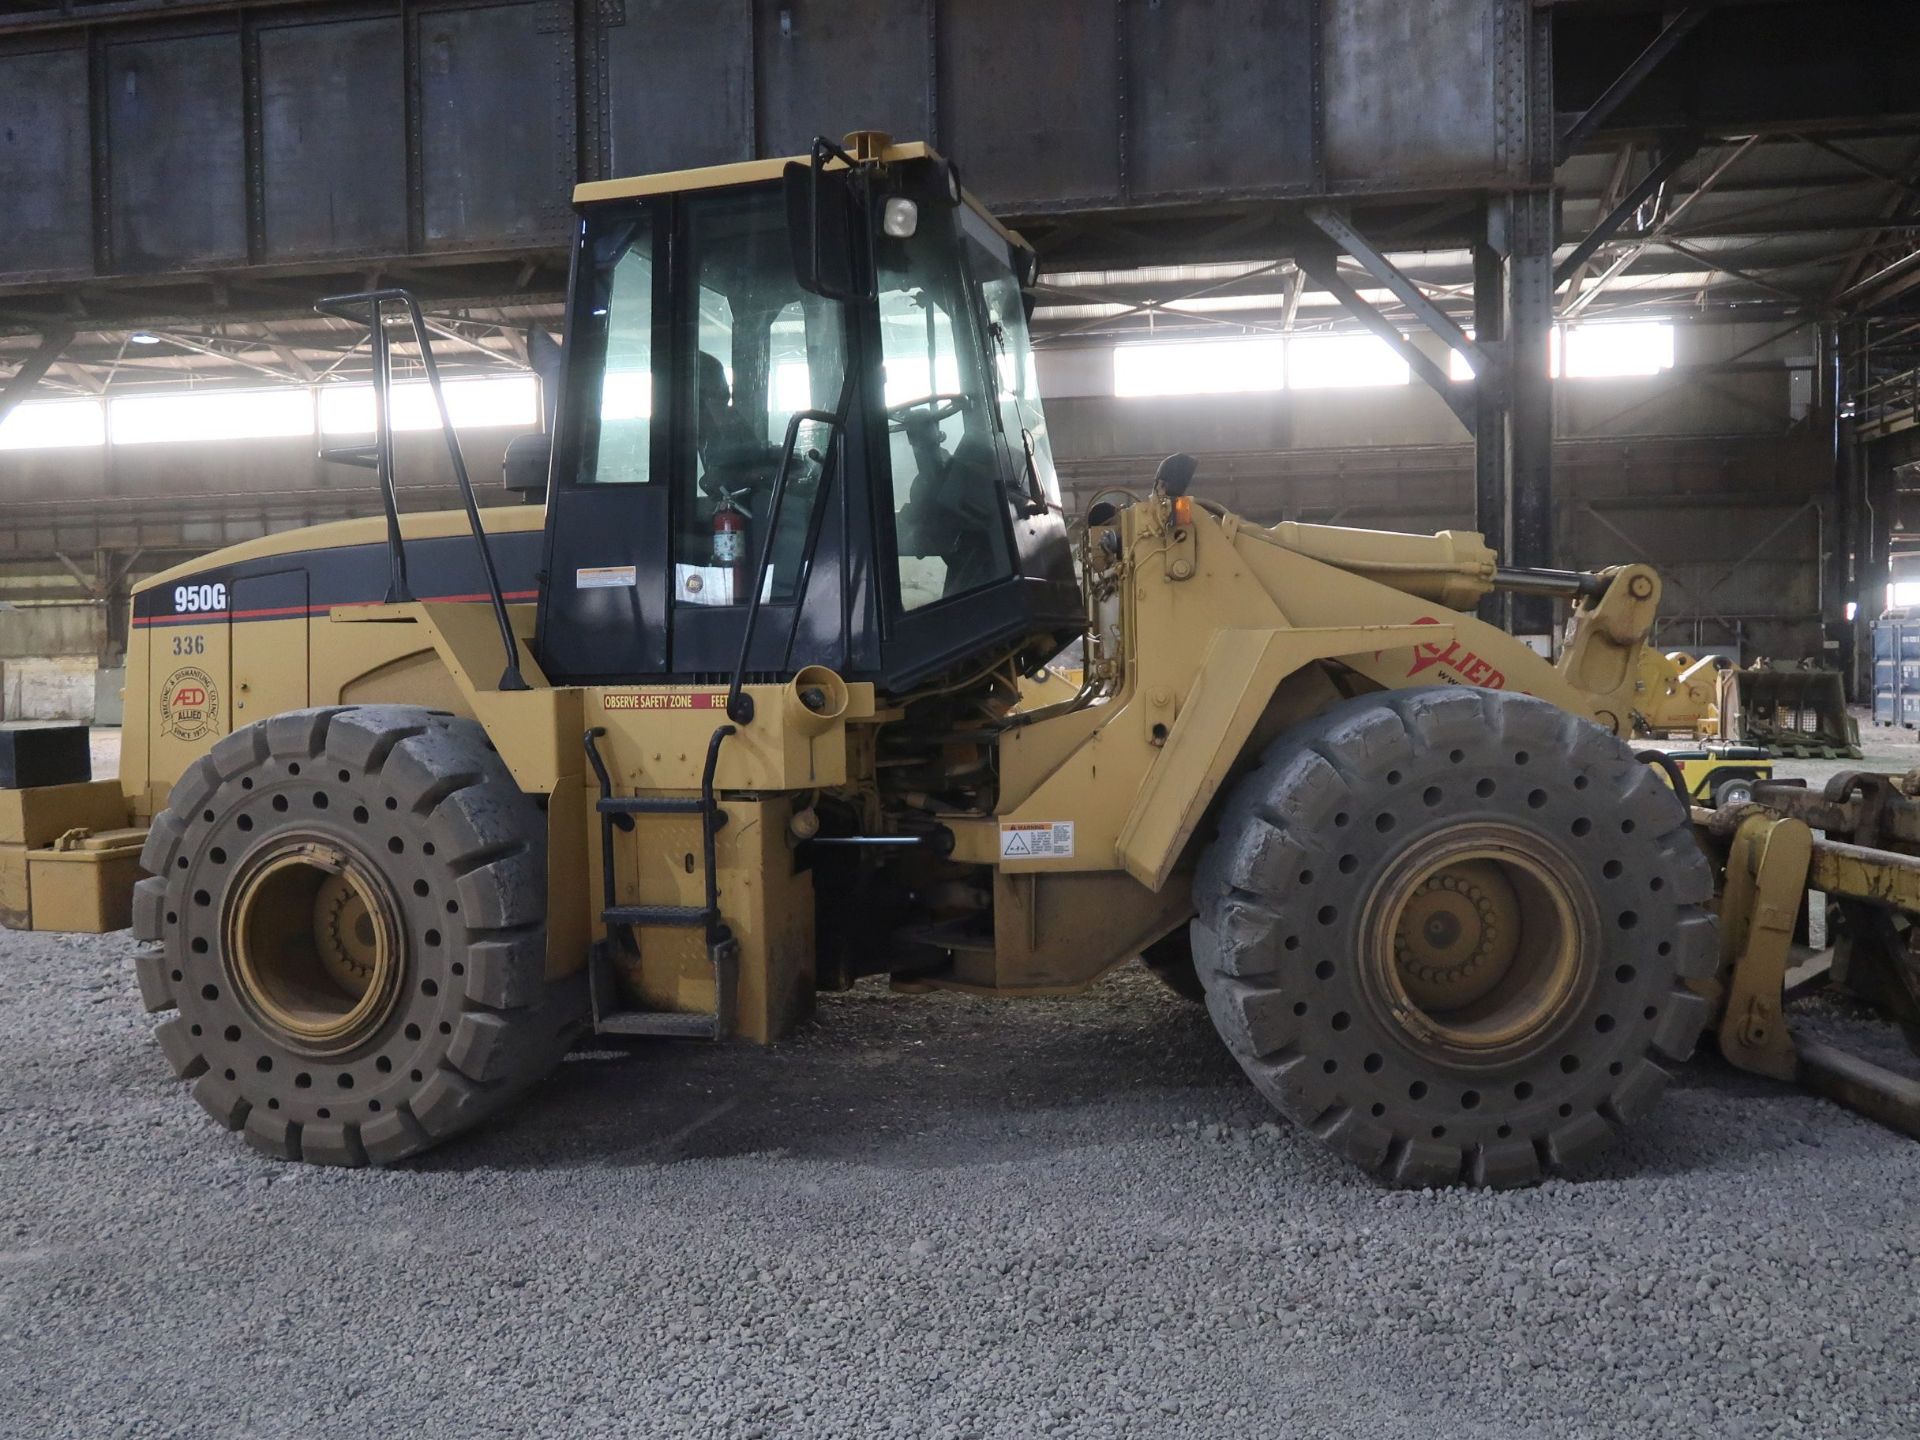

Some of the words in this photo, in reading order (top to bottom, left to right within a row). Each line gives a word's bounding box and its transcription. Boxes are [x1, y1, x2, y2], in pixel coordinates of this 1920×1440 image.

[175, 583, 226, 612] 950G
[173, 634, 205, 656] 336
[172, 688, 205, 707] AED
[605, 696, 639, 708] OBSERVE
[640, 695, 669, 708] SAFETY
[670, 695, 692, 707] ZONE
[711, 694, 728, 707] FEET
[178, 711, 202, 720] ALLIED
